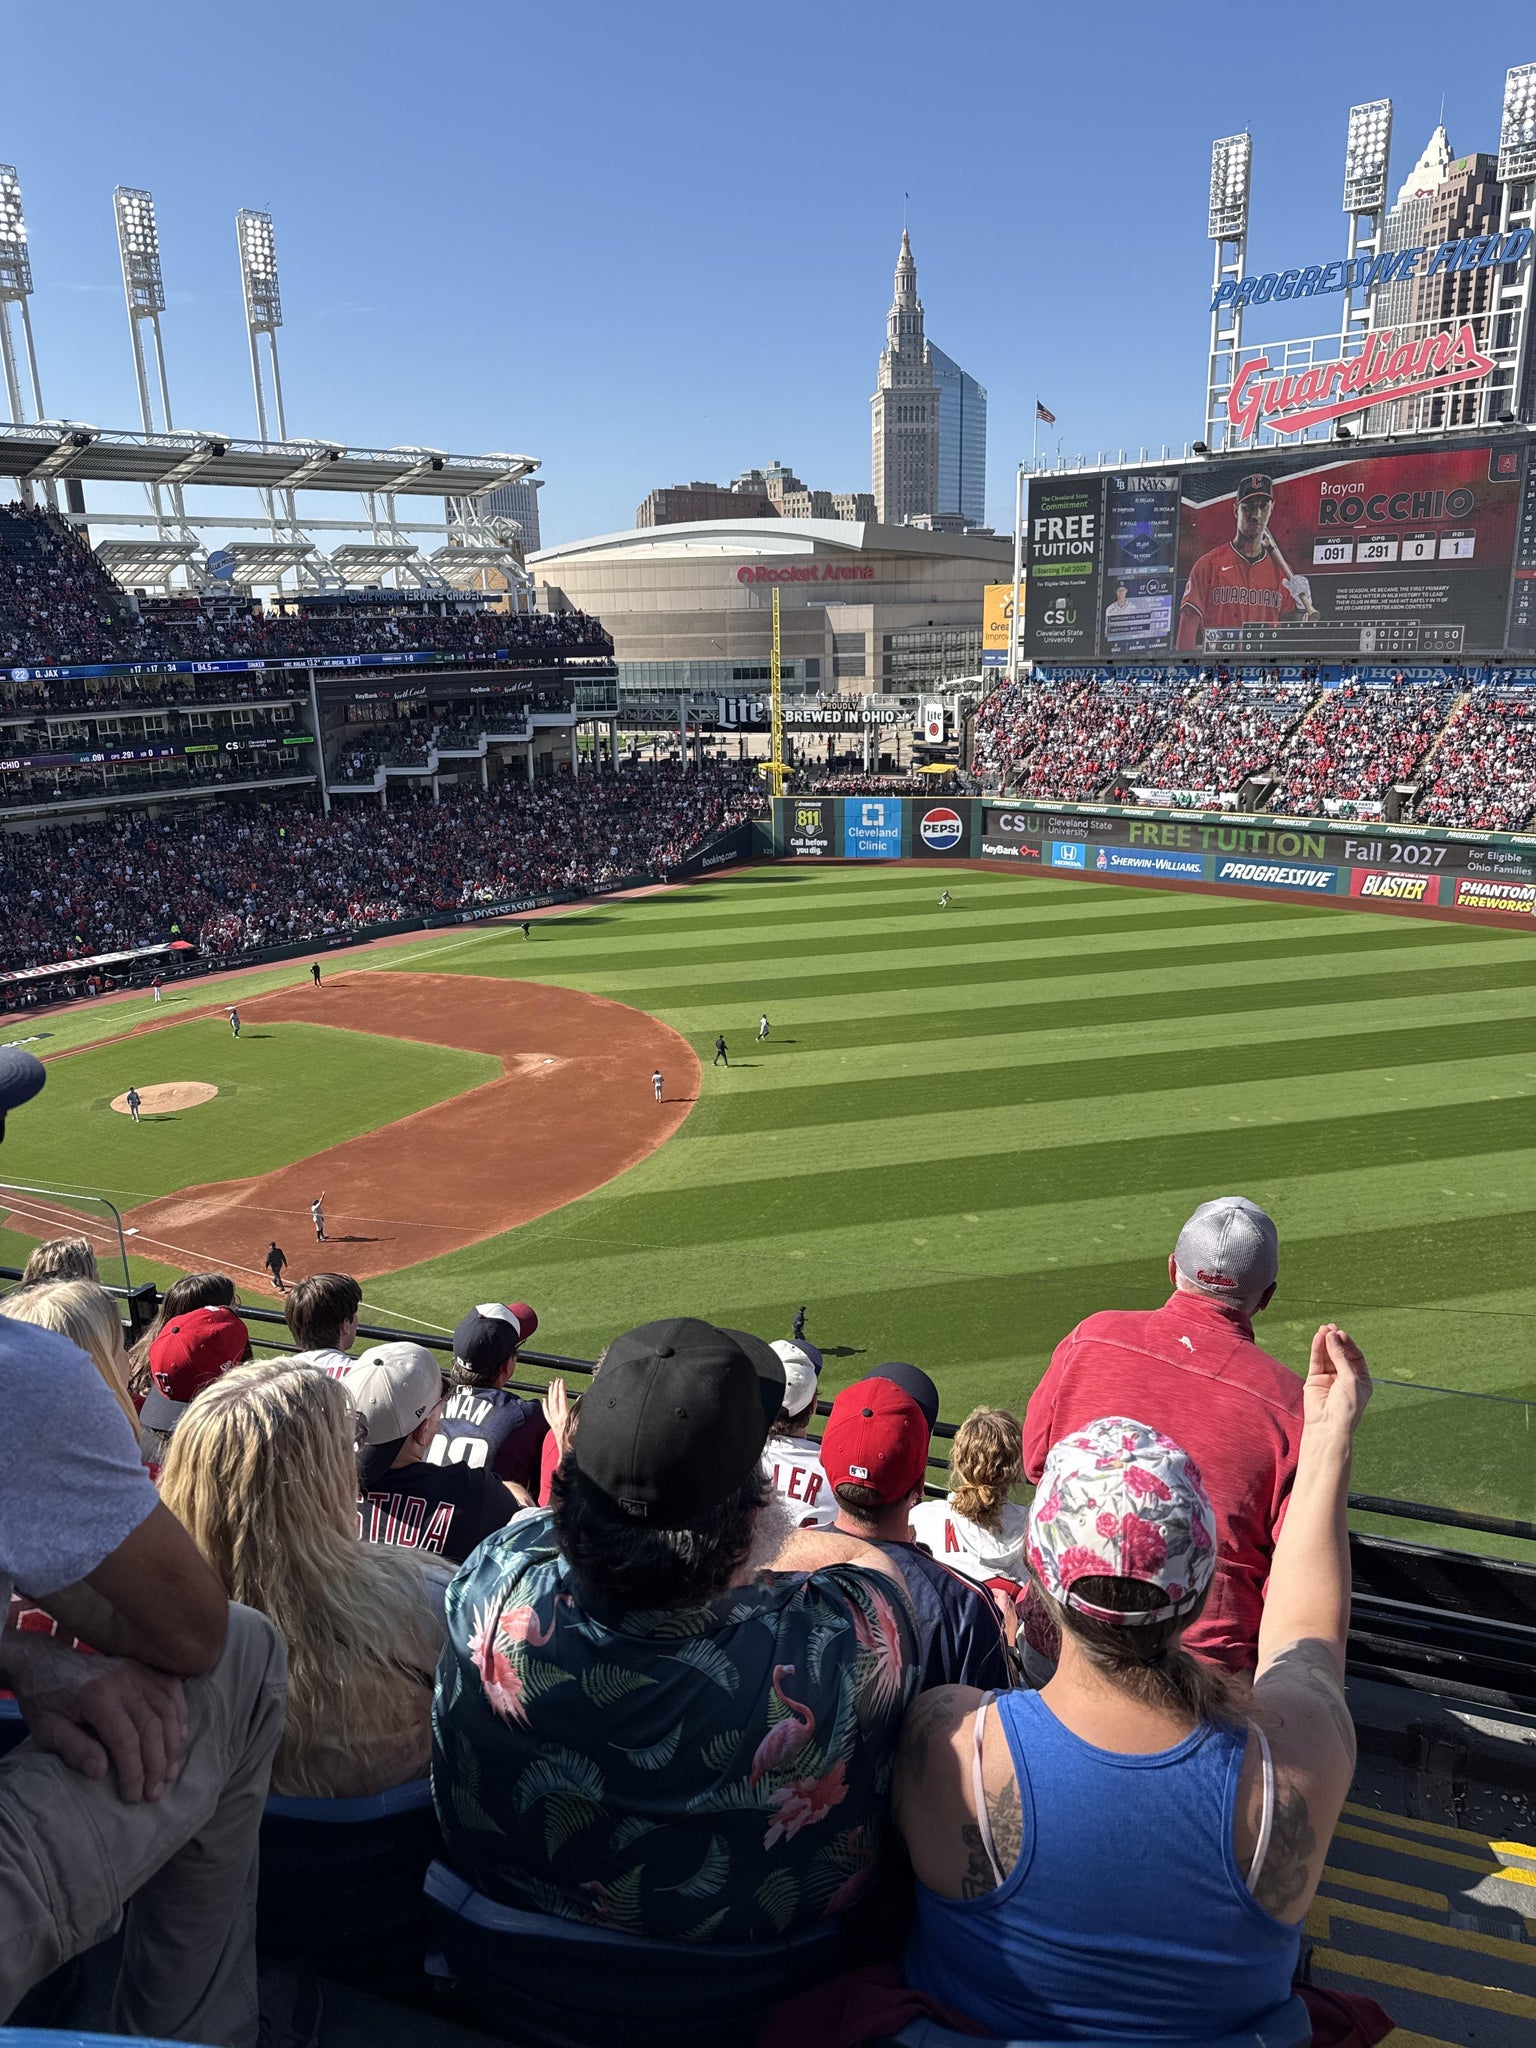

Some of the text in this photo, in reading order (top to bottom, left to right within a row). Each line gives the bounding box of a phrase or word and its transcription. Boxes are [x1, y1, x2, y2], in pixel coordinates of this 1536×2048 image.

[1210, 227, 1534, 312] PROGRESSIVE FIELD
[1227, 323, 1497, 445] Guardians
[1115, 477, 1167, 492] TB RAYS
[1320, 481, 1365, 498] Brayan
[1041, 501, 1088, 511] Commitment
[1319, 488, 1475, 526] ROCCHIO
[1034, 515, 1095, 541] FREE
[1033, 541, 1094, 557] TUITION
[1320, 547, 1345, 560] .091
[1364, 544, 1389, 559] .291
[1415, 543, 1423, 556] 0
[1453, 541, 1459, 555] 1
[755, 564, 875, 583] Rocket Arena
[1037, 565, 1087, 575] Starting Fall 2027
[375, 591, 399, 601] MOON
[402, 590, 442, 601] TERRACE
[446, 590, 483, 601] GARDEN
[1043, 610, 1077, 625] CSU
[1036, 629, 1083, 638] Cleveland State
[1044, 636, 1075, 644] University
[1451, 630, 1459, 638] 0
[15, 670, 25, 679] 22
[44, 669, 58, 678] JAX
[167, 664, 176, 672] 34
[1051, 667, 1451, 679] HONDA HONDA HONDA
[717, 697, 764, 729] Lite
[821, 702, 858, 711] PROUDLY
[785, 710, 895, 723] BREWED IN OHIO
[927, 710, 942, 723] Lite
[225, 741, 246, 751] CSU
[91, 754, 105, 762] .091
[121, 751, 135, 759] .291
[992, 800, 1021, 808] PROGRESSIVE
[1033, 803, 1065, 811] PROGRESSIVE
[1076, 805, 1109, 814] PROGRESSIVE
[797, 810, 819, 826] 811
[1121, 808, 1156, 817] PROGRESSIVE
[1169, 811, 1206, 820] PROGRESSIVE
[999, 814, 1040, 833] CSU
[1048, 817, 1113, 831] Cleveland State
[1219, 815, 1257, 824] PROGRESSIVE
[1272, 818, 1312, 827] PROGRESSIVE
[848, 827, 898, 838] Cleveland
[923, 824, 960, 834] PEPSI
[1048, 827, 1089, 838] University
[1327, 822, 1369, 832] PROGRESSIVE
[1385, 826, 1428, 836] PROGRESSIVE
[791, 838, 828, 846] Call before
[1128, 822, 1325, 859] FREE TUITION
[1446, 831, 1492, 841] PROGRESSIVE
[796, 847, 822, 856] you dig.
[858, 840, 888, 851] Clinic
[982, 843, 1019, 856] KeyBank
[702, 851, 738, 867] Booking.com
[1344, 840, 1447, 867] Fall 2027
[1469, 850, 1522, 863] For Eligible
[1054, 859, 1082, 868] HONDA
[1467, 862, 1532, 876] Ohio Families
[1219, 862, 1335, 888] PROGRESSIVE
[1361, 875, 1428, 900] BLASTER
[1460, 881, 1536, 900] PHANTOM
[473, 900, 536, 920] POSTSEASON
[1457, 895, 1534, 912] FIREWORKS
[440, 1393, 494, 1426] WAN
